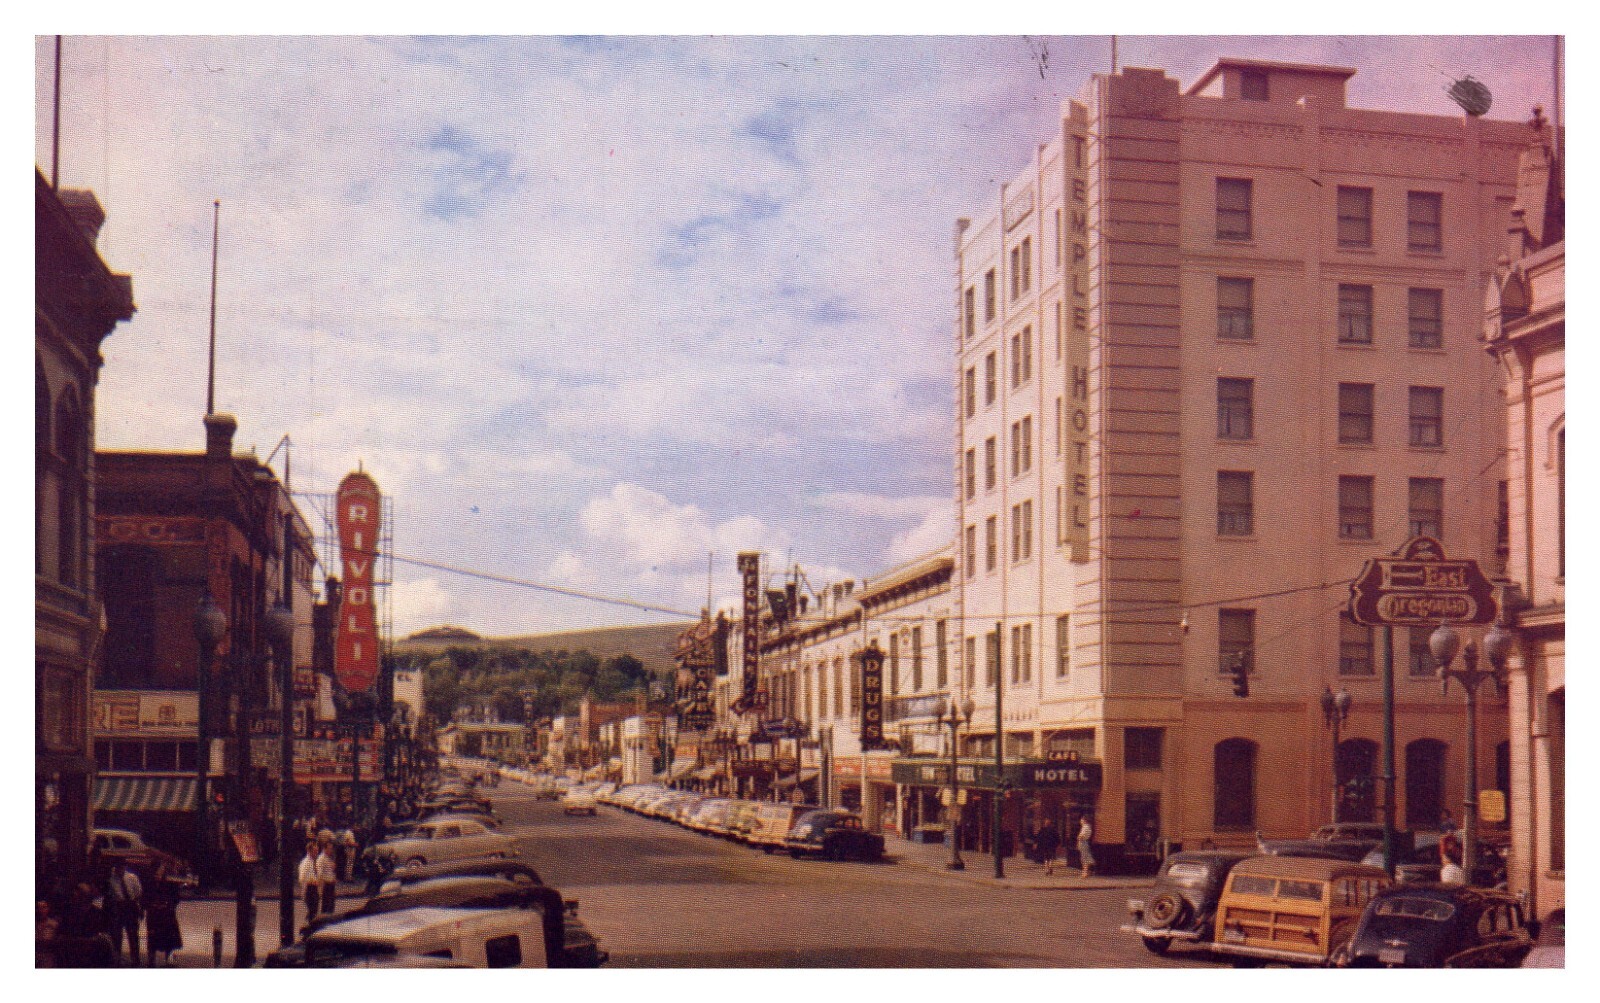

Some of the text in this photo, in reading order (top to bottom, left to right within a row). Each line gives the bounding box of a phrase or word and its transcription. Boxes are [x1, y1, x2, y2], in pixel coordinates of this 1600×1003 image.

[1072, 134, 1087, 529] TEMPLE HOTEL
[348, 504, 369, 662] RIVOLI
[865, 659, 880, 739] DRUGS
[1034, 769, 1089, 781] HOTEL
[1048, 751, 1077, 761] CAFE
